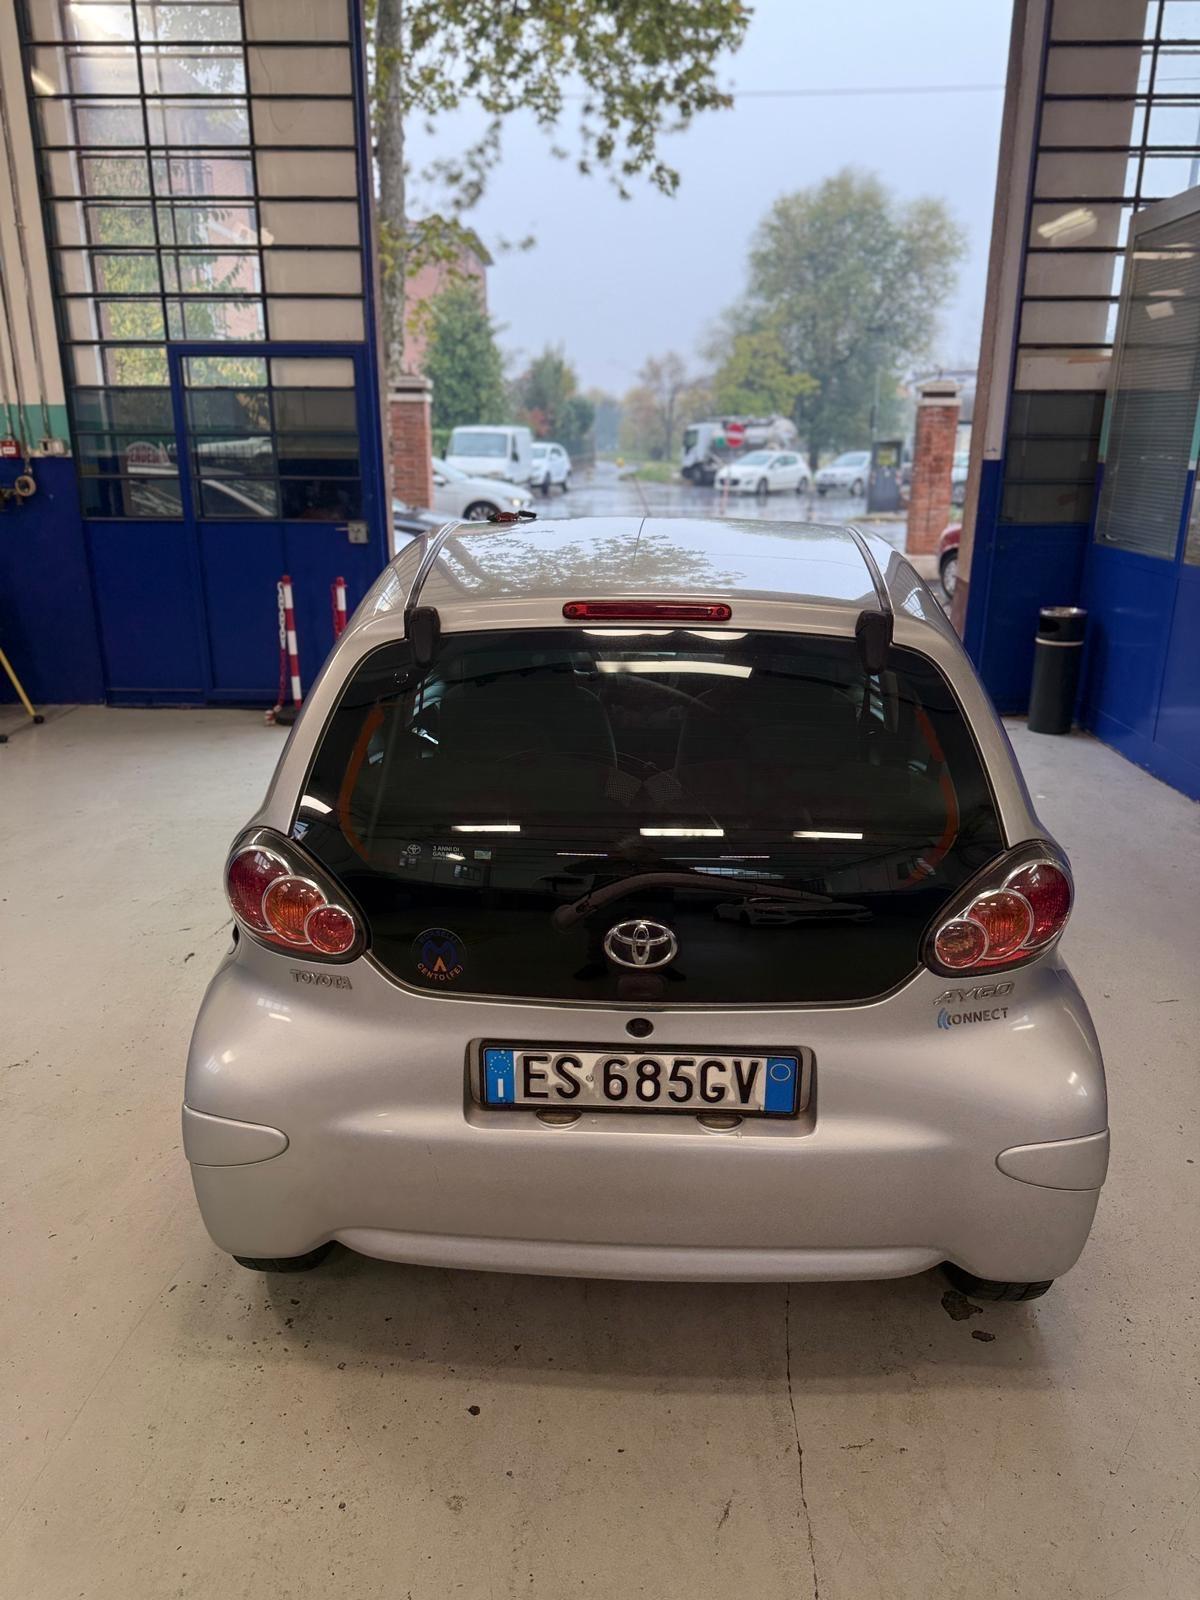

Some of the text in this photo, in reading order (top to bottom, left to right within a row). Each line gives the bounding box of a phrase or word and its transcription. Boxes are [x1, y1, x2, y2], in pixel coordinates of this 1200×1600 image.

[290, 968, 352, 990] TOYOTA
[933, 982, 1014, 1005] AYGO
[937, 1007, 1009, 1030] CONNECT
[523, 1055, 760, 1104] ES 685GV
